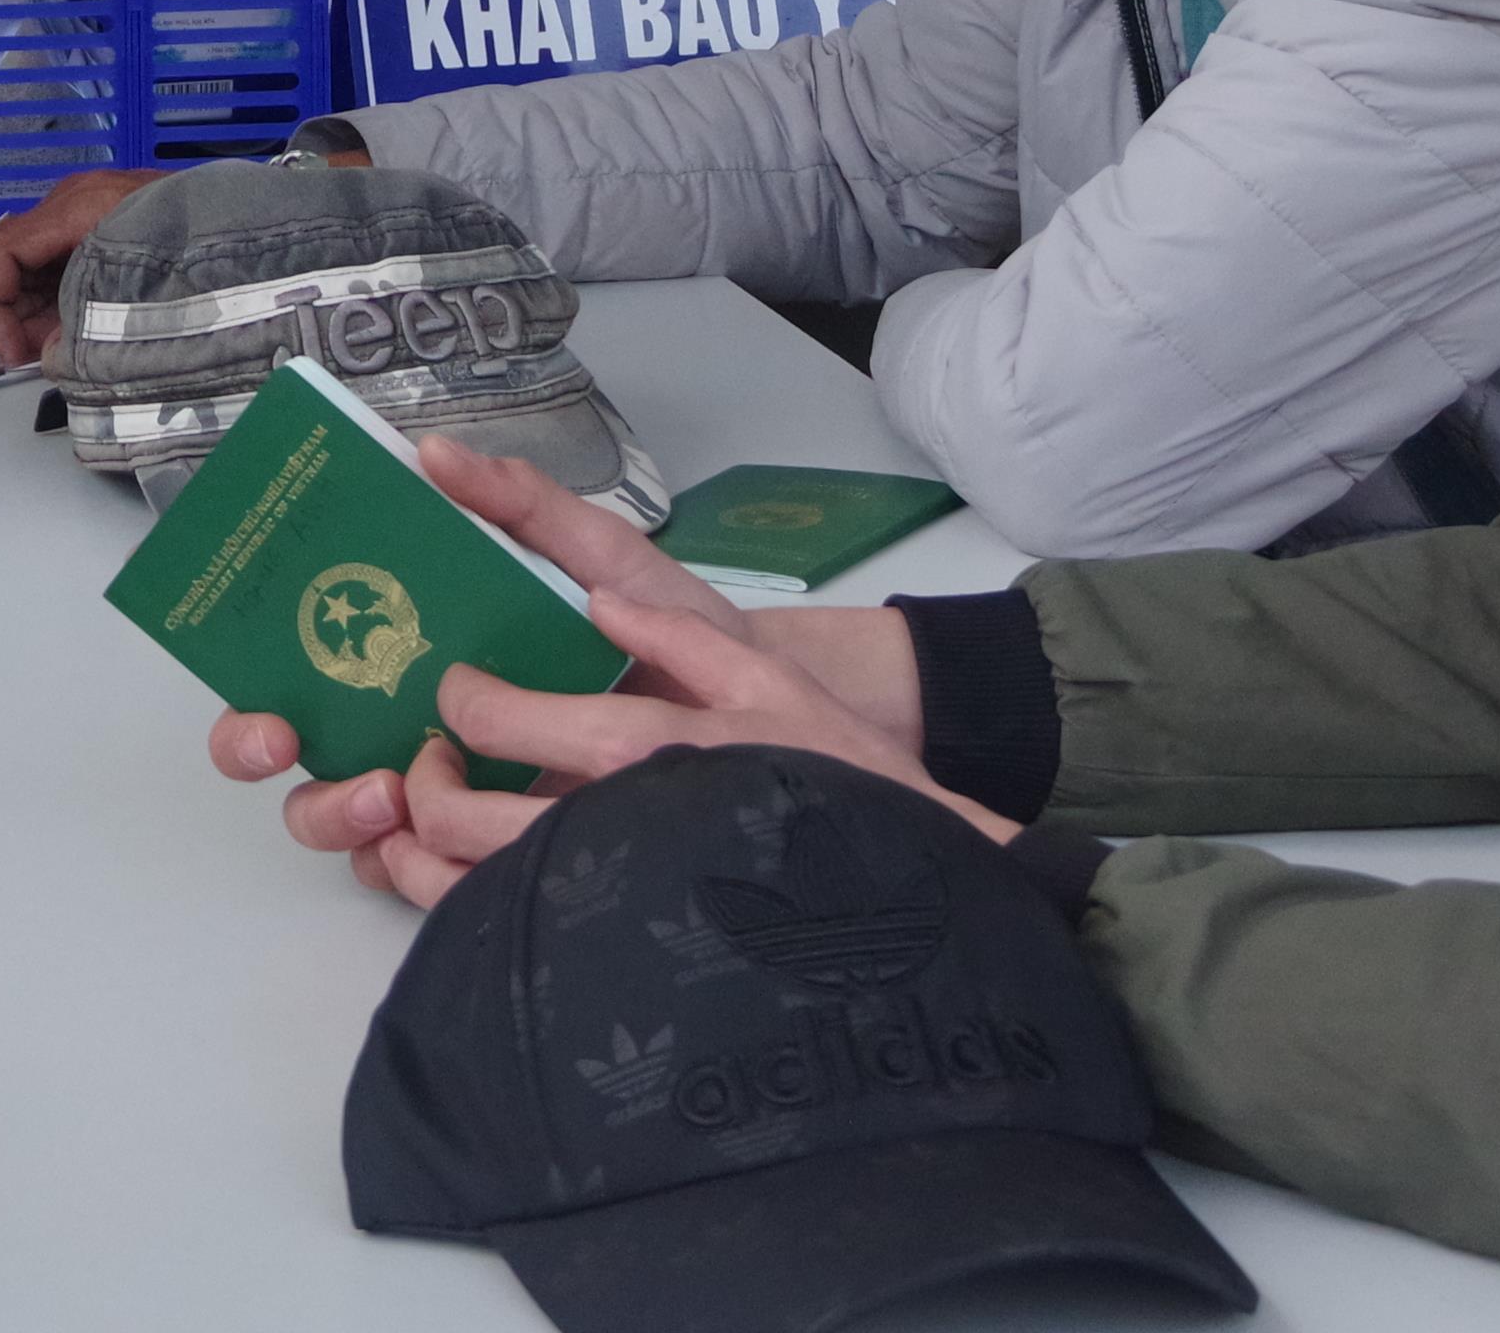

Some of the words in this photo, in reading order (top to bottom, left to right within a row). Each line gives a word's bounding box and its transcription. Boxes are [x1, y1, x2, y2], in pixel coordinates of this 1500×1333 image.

[273, 284, 520, 375] Jeep
[189, 569, 237, 627] SOCIALIST
[231, 516, 277, 572] REPUBLIC
[272, 498, 291, 518] OF
[285, 447, 331, 503] VIETNAM
[676, 995, 1057, 1127] adidas
